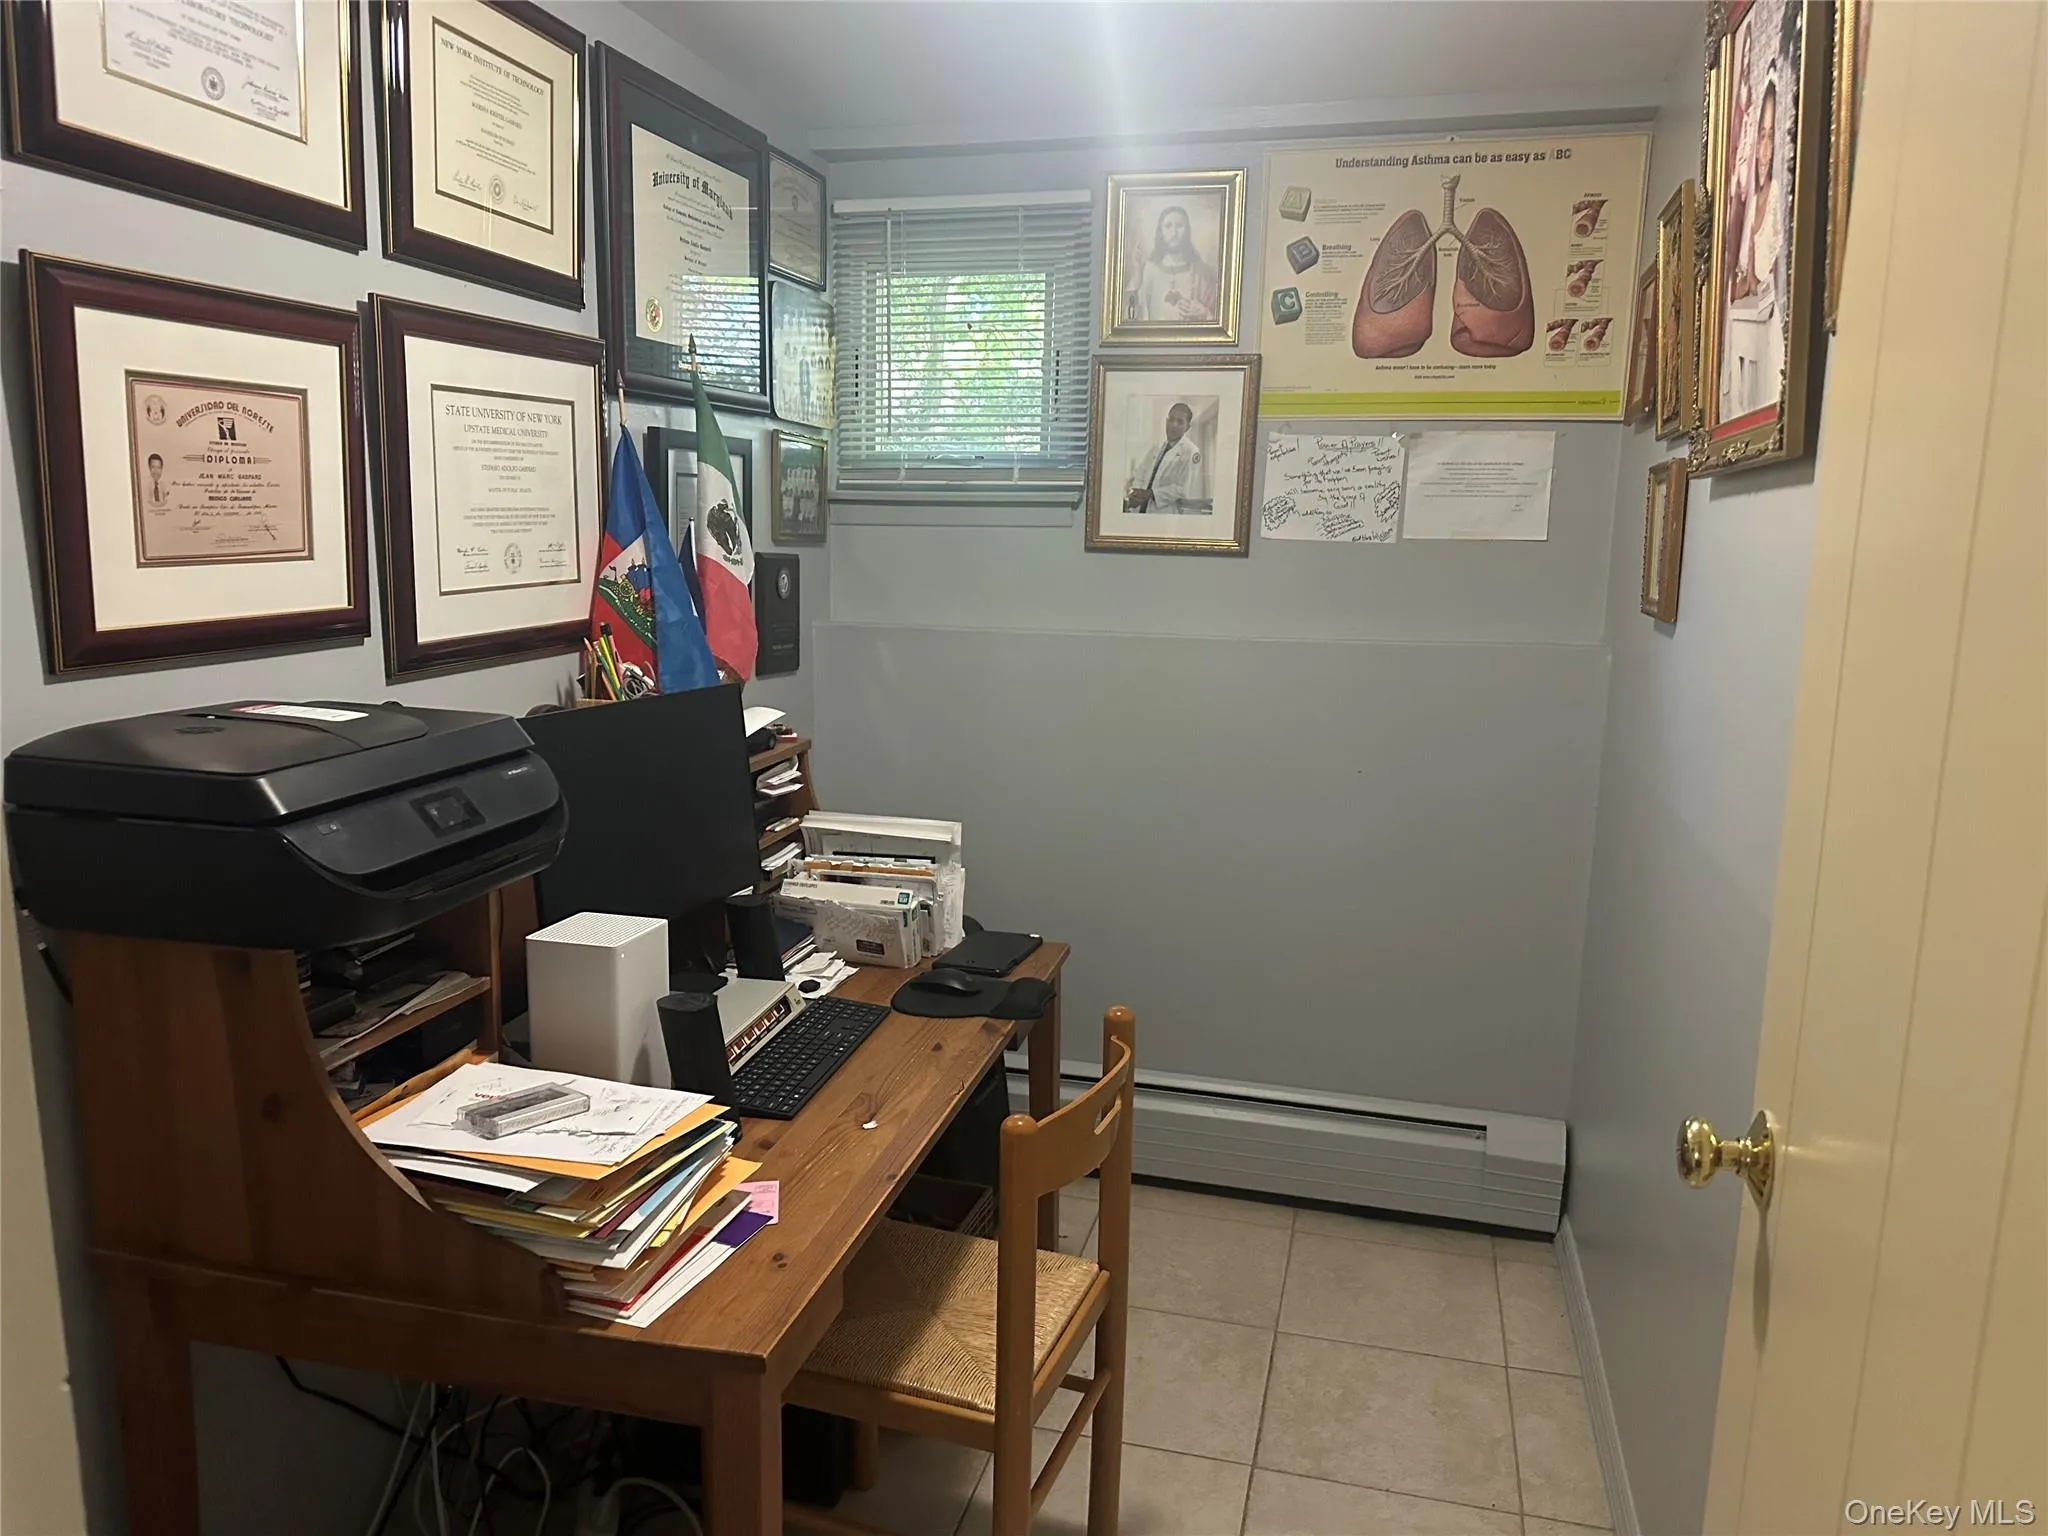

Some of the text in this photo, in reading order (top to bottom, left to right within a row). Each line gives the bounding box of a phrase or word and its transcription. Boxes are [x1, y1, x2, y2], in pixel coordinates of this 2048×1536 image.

[441, 38, 545, 96] NEW YORK INSTITUTE OF TECHNOLOGY
[1335, 157, 1409, 169] Understanding
[1411, 155, 1450, 167] Asthma
[1453, 155, 1472, 164] can
[1474, 153, 1488, 164] be
[1490, 154, 1503, 163] as
[1505, 153, 1531, 164] easy
[1532, 152, 1546, 162] as
[652, 171, 691, 190] University
[692, 176, 700, 191] of
[1322, 243, 1352, 251] Breathing
[1280, 292, 1296, 310] C
[175, 400, 275, 434] UNIVERSIDAD DEL NORESTE
[445, 404, 562, 425] STATE UNIVERSITY OF NEW YORK
[464, 424, 548, 438] UPSTATE MEDICAL UNIVERSITY
[206, 455, 252, 464] DIPLOMA
